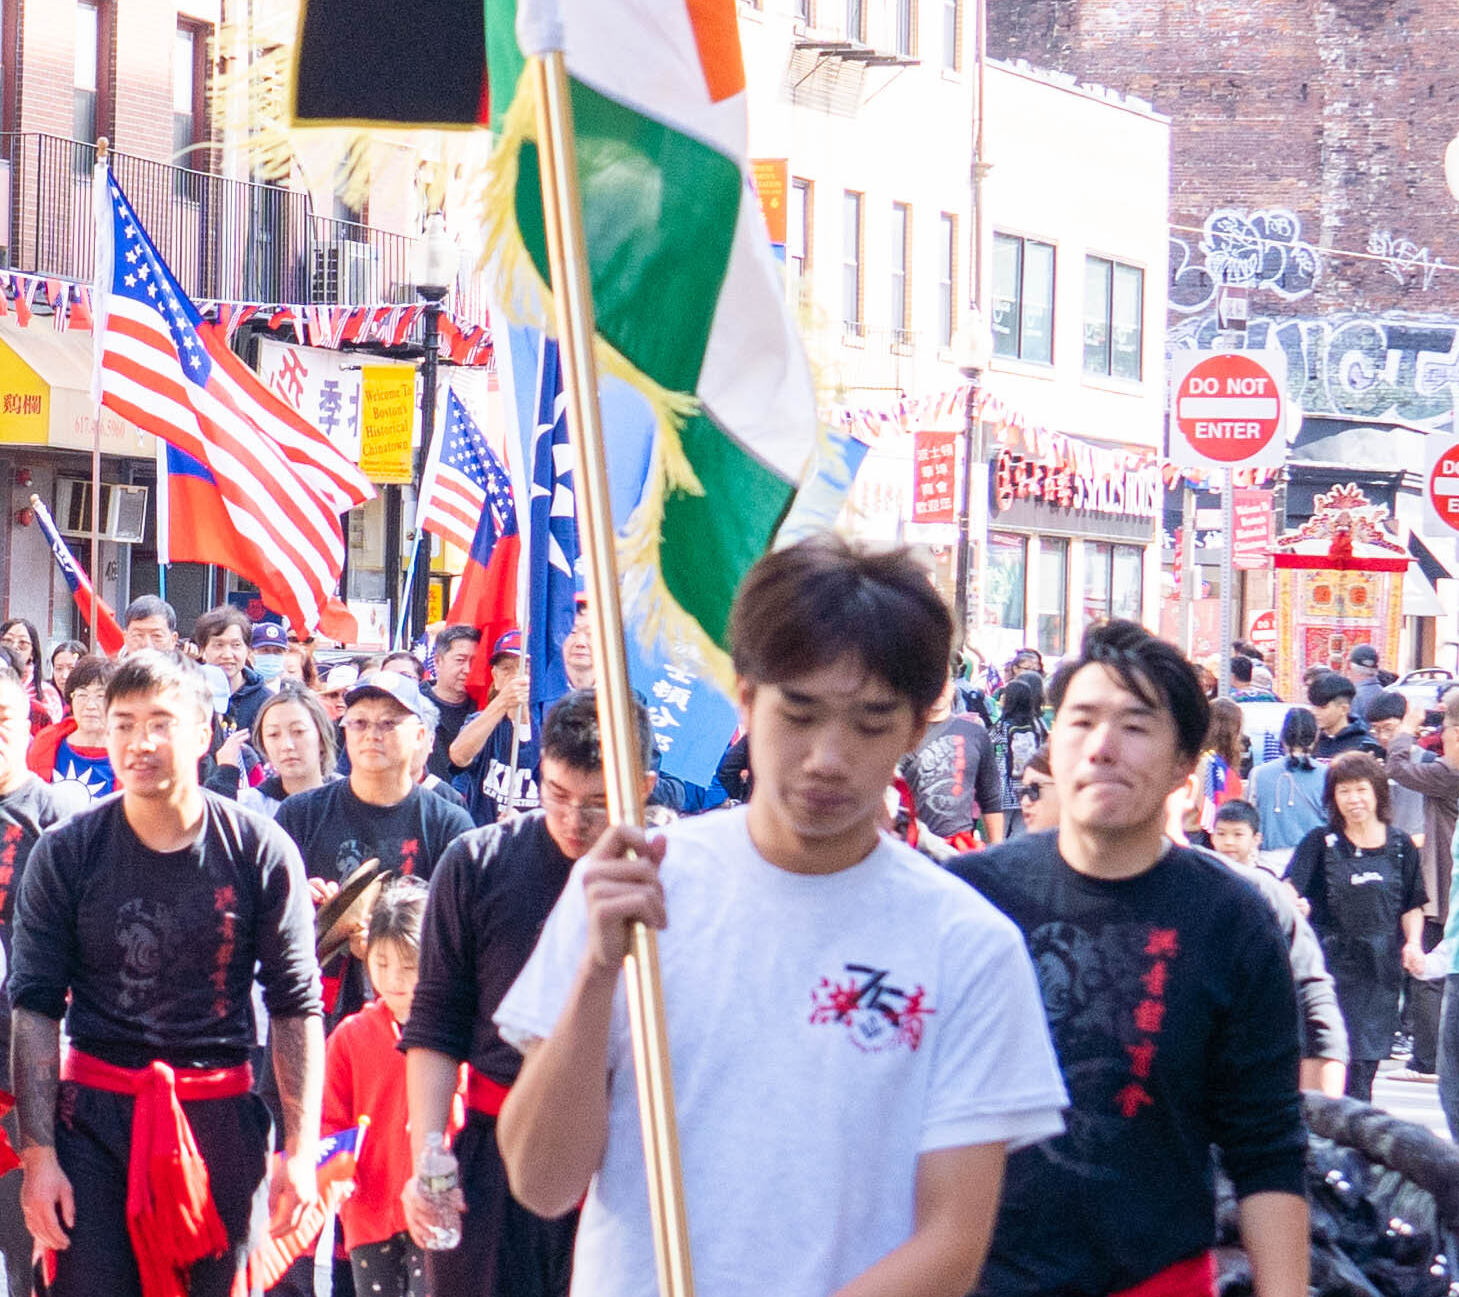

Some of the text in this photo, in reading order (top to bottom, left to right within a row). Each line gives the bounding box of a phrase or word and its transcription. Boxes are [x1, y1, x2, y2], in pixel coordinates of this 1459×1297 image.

[364, 384, 413, 404] Welcome To
[1188, 377, 1269, 395] DO NOT
[372, 405, 409, 420] Boston's
[365, 421, 409, 439] Historical
[1194, 421, 1261, 440] ENTER
[362, 440, 409, 457] Chinatown
